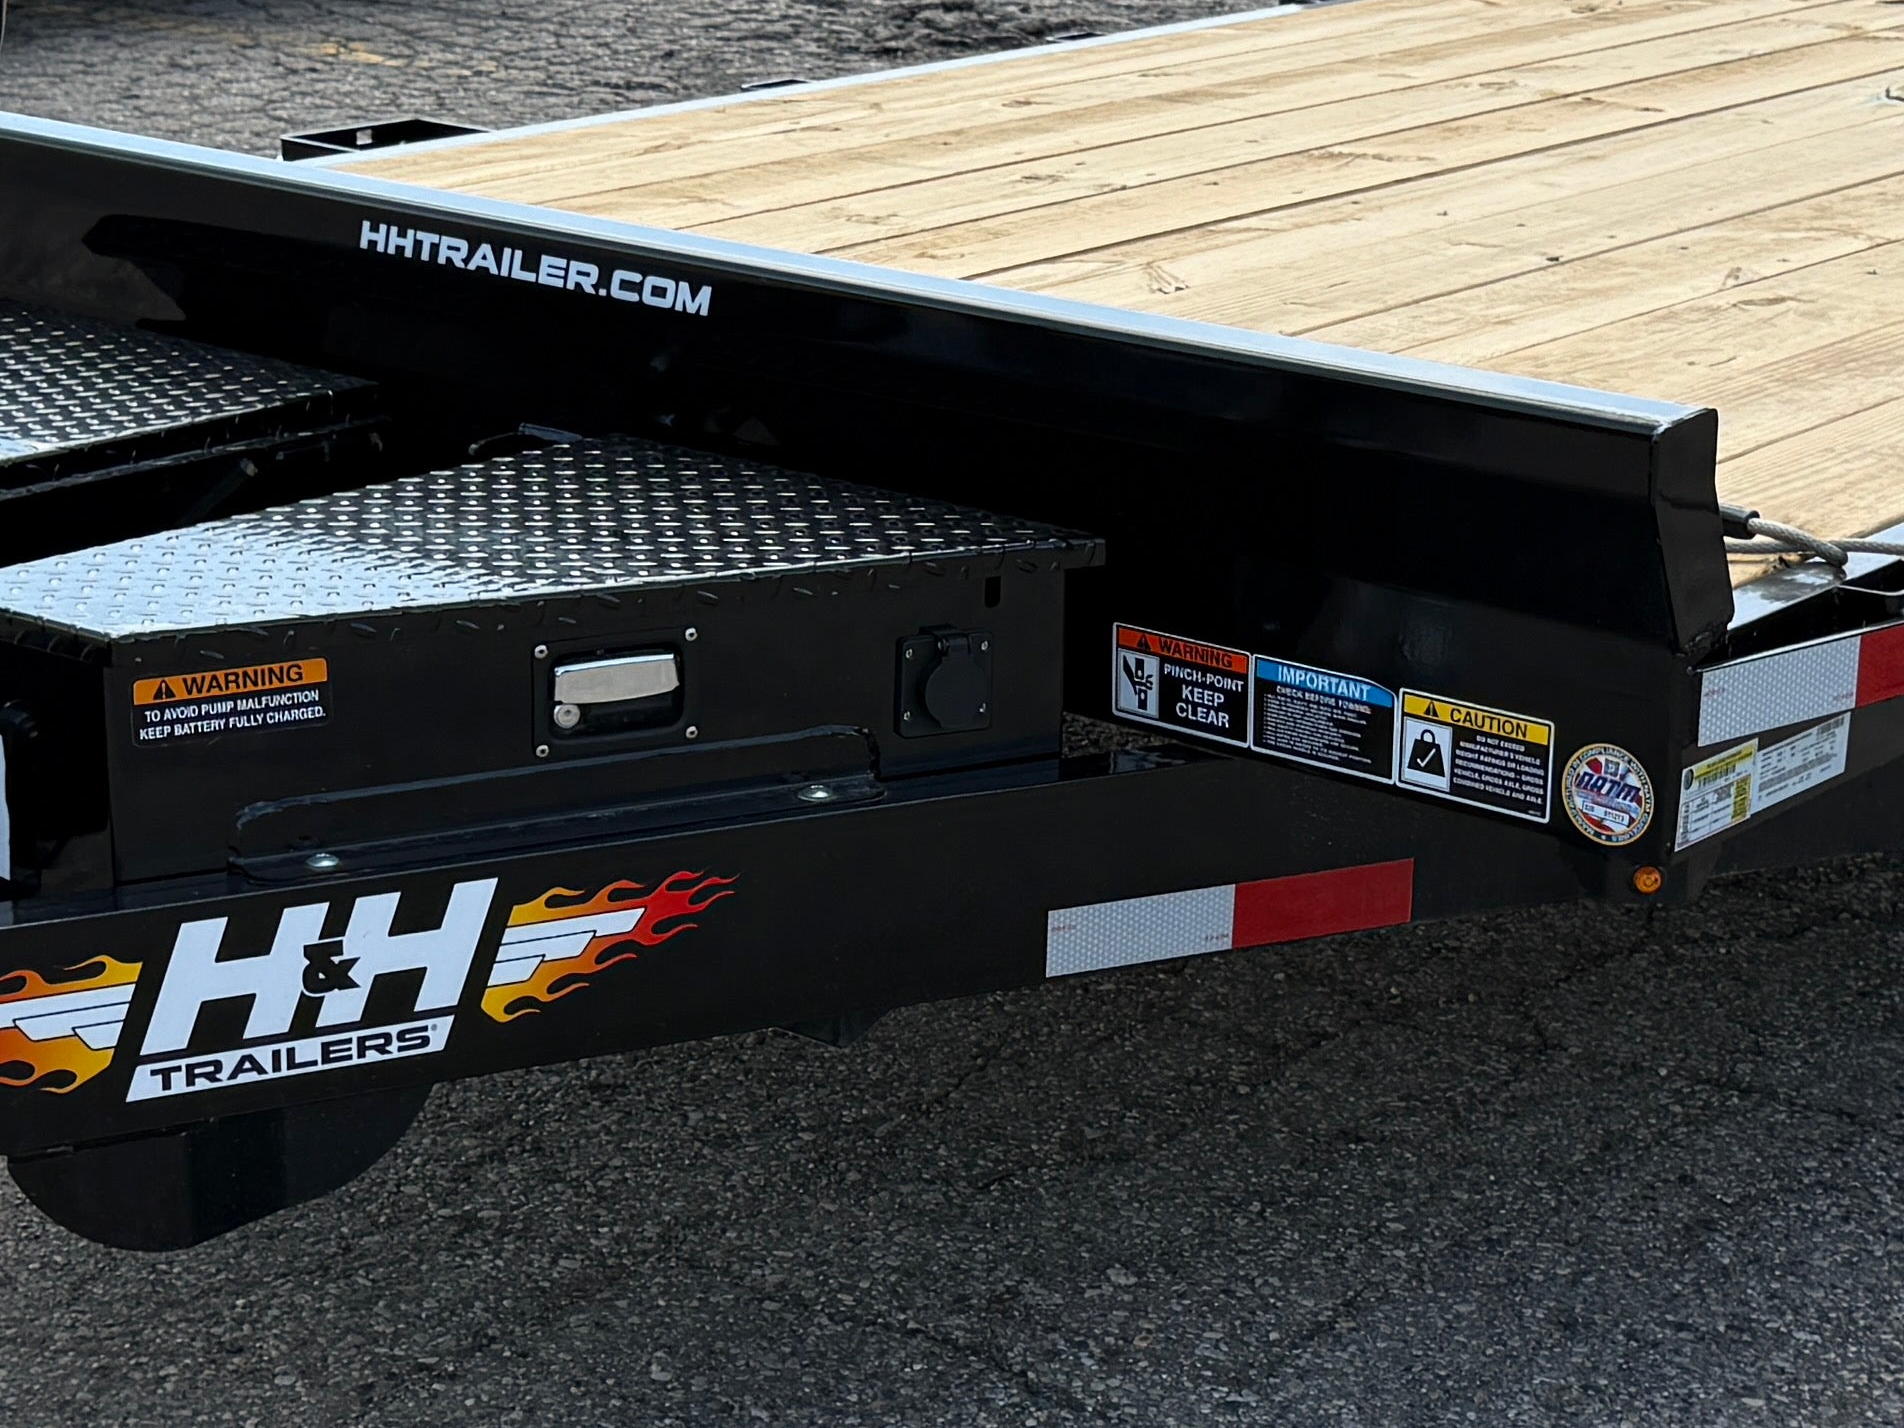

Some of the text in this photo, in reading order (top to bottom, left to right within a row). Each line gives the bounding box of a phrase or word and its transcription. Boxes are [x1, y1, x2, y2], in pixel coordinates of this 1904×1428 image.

[359, 220, 712, 316] HHTRAILER.COM
[1158, 637, 1233, 669] WARNING
[183, 664, 304, 695] WARNING
[1164, 663, 1244, 692] PINCH-POINT
[1276, 685, 1303, 699] CHECK
[1278, 665, 1372, 701] IMPORTANT
[145, 689, 319, 722] TO AVOID PUMP MALFUNCTION
[1182, 684, 1224, 707] KEEP
[140, 705, 326, 740] KEEP BATTERY FULLY CHARGED.
[1176, 702, 1229, 728] CLEAR
[1450, 708, 1528, 738] CAUTION
[139, 877, 499, 1056] H&H
[149, 1027, 433, 1093] TRAILERS
